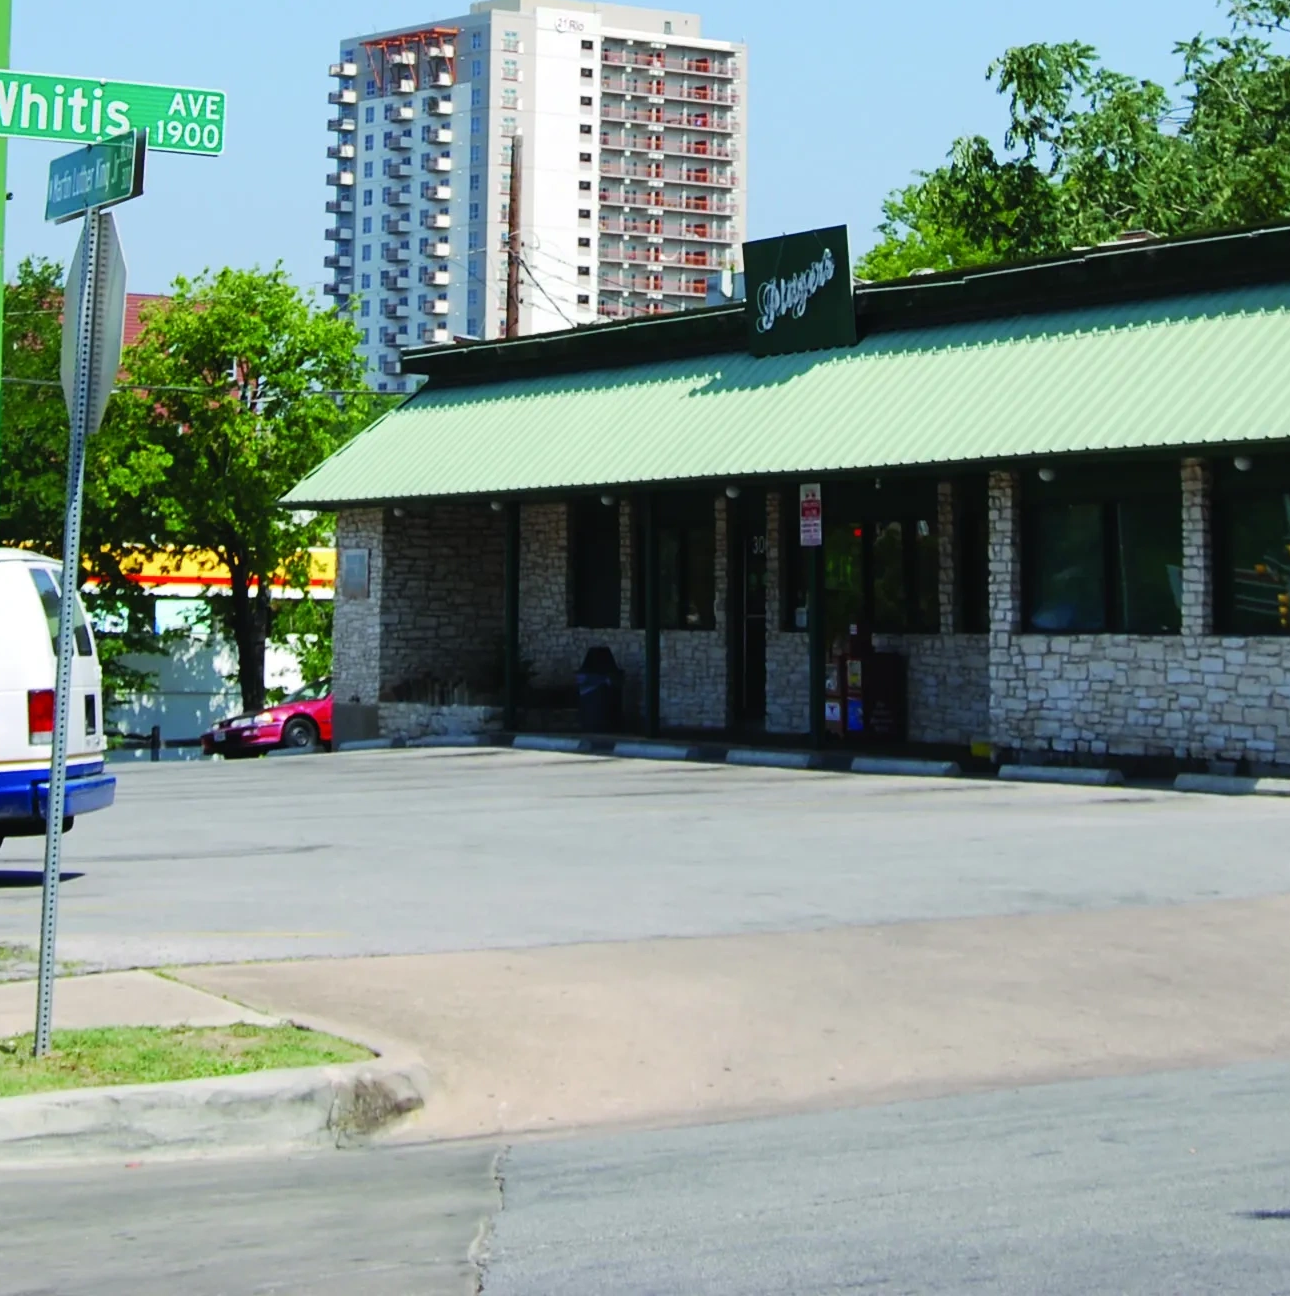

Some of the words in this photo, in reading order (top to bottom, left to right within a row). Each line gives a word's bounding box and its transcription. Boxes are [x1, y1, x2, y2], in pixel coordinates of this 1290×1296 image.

[569, 19, 584, 32] Rio
[168, 92, 222, 120] AVE
[157, 120, 220, 148] 1900
[72, 164, 95, 196] Luther
[95, 157, 110, 193] King
